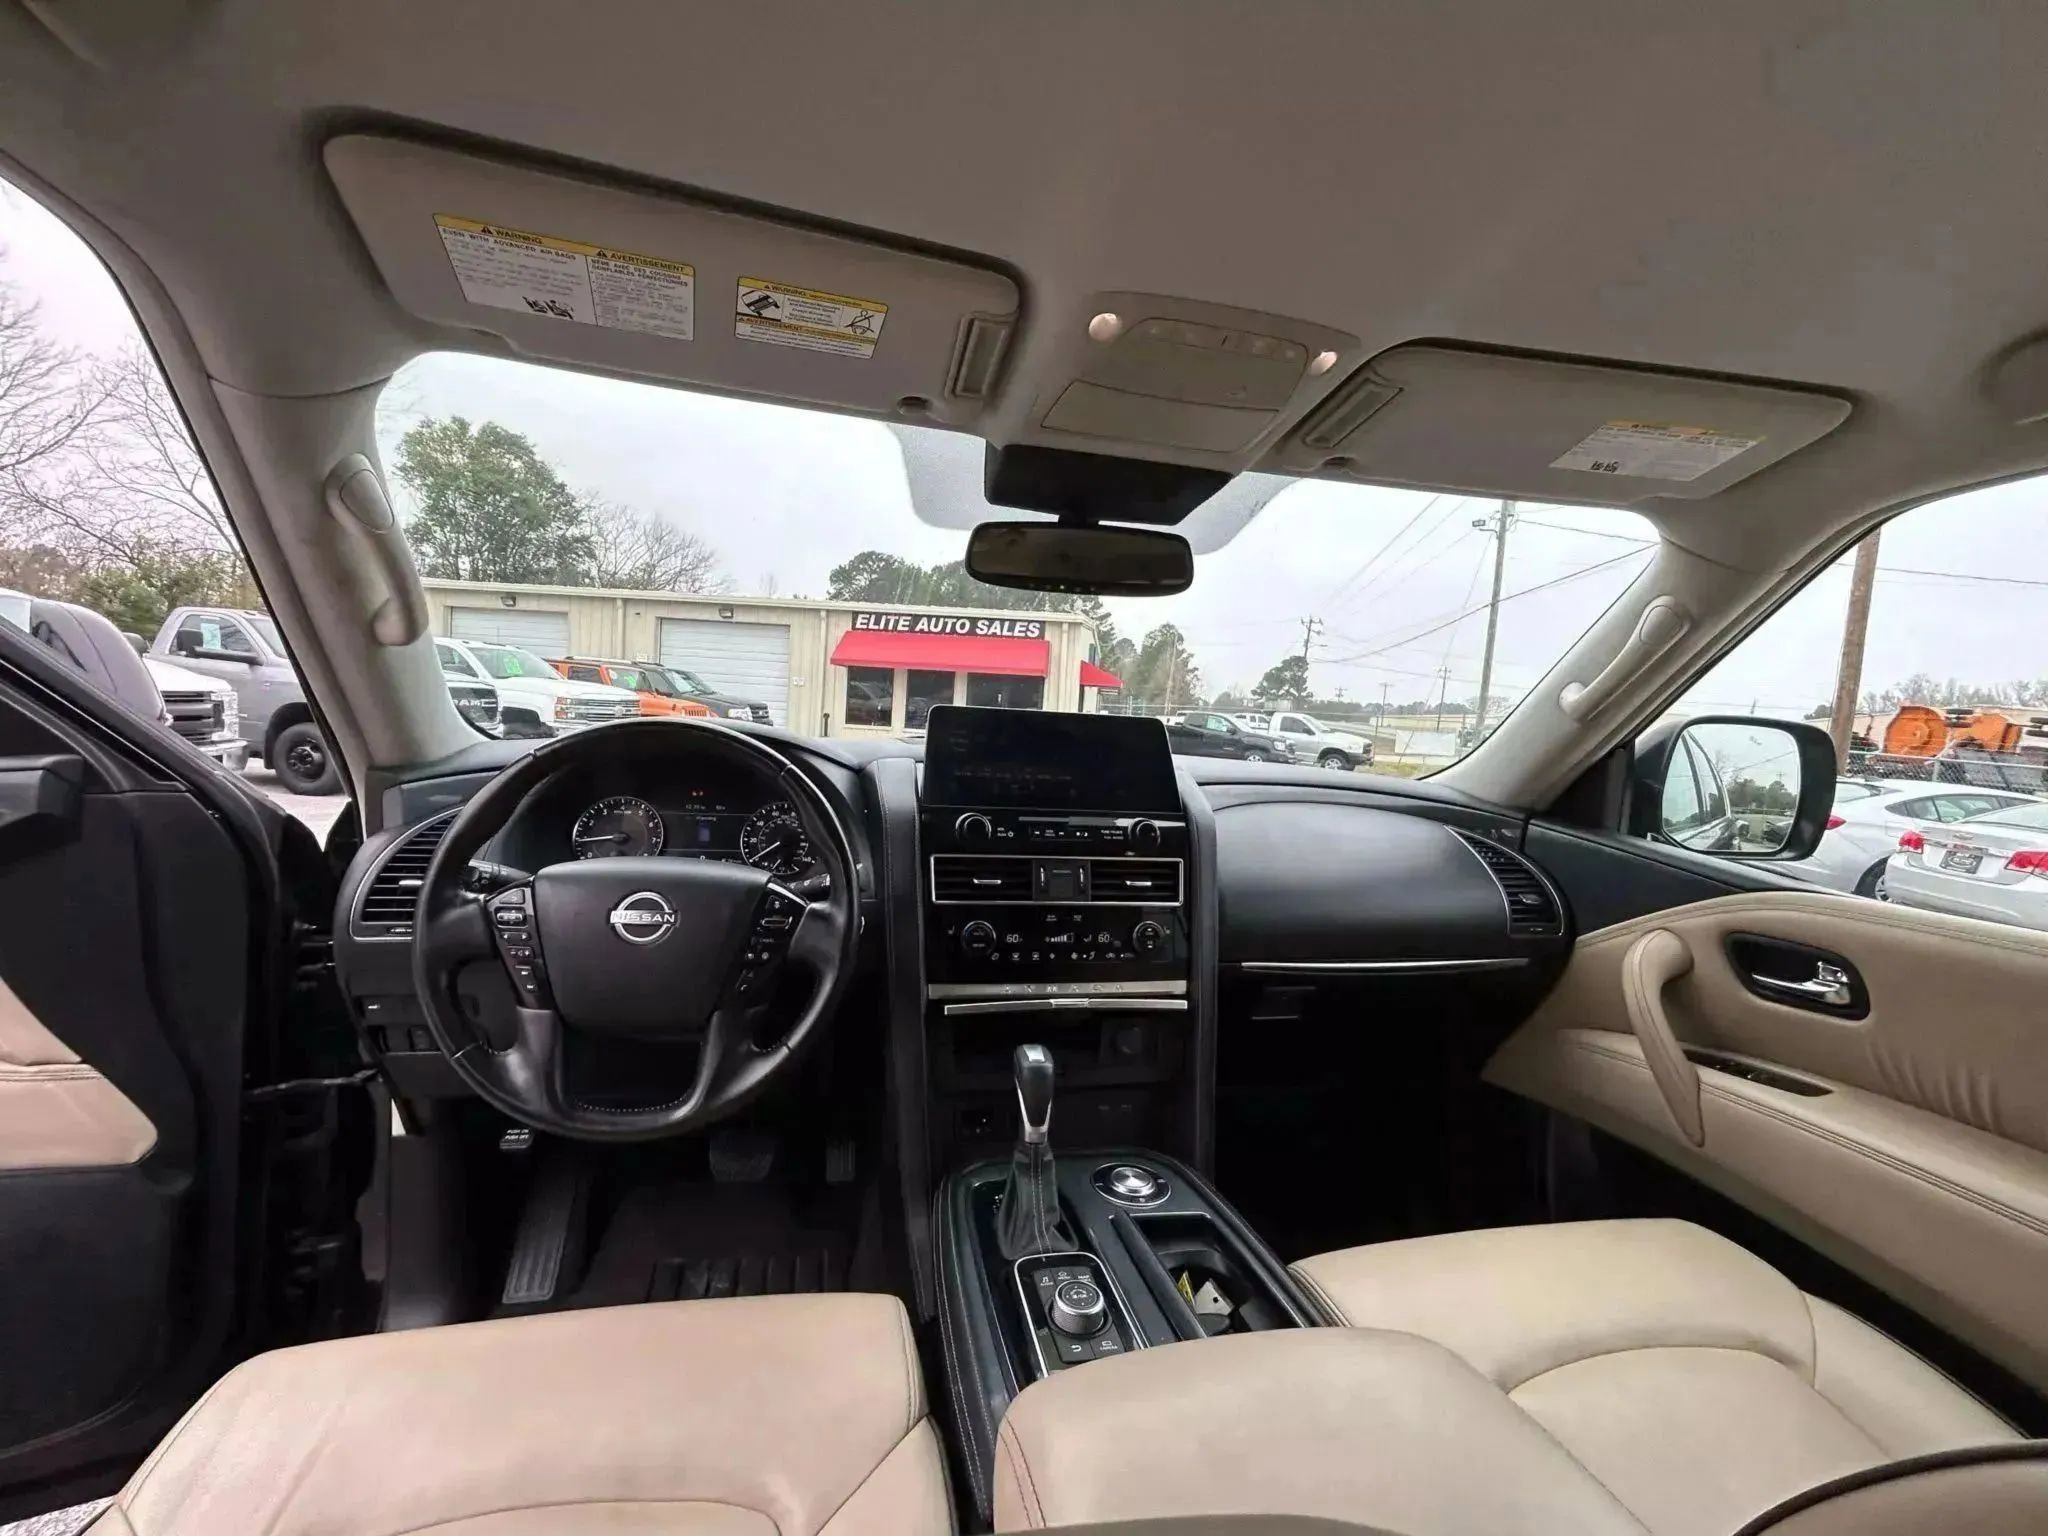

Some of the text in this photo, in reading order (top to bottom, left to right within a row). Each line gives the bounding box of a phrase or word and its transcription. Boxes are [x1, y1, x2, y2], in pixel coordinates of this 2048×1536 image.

[495, 228, 544, 245] WARNING
[610, 253, 685, 273] AVERTISSEMENT
[855, 614, 1040, 638] ELITE AUTO SALES
[613, 912, 675, 923] NISSAN
[1006, 933, 1019, 943] 60
[1098, 934, 1110, 944] 60
